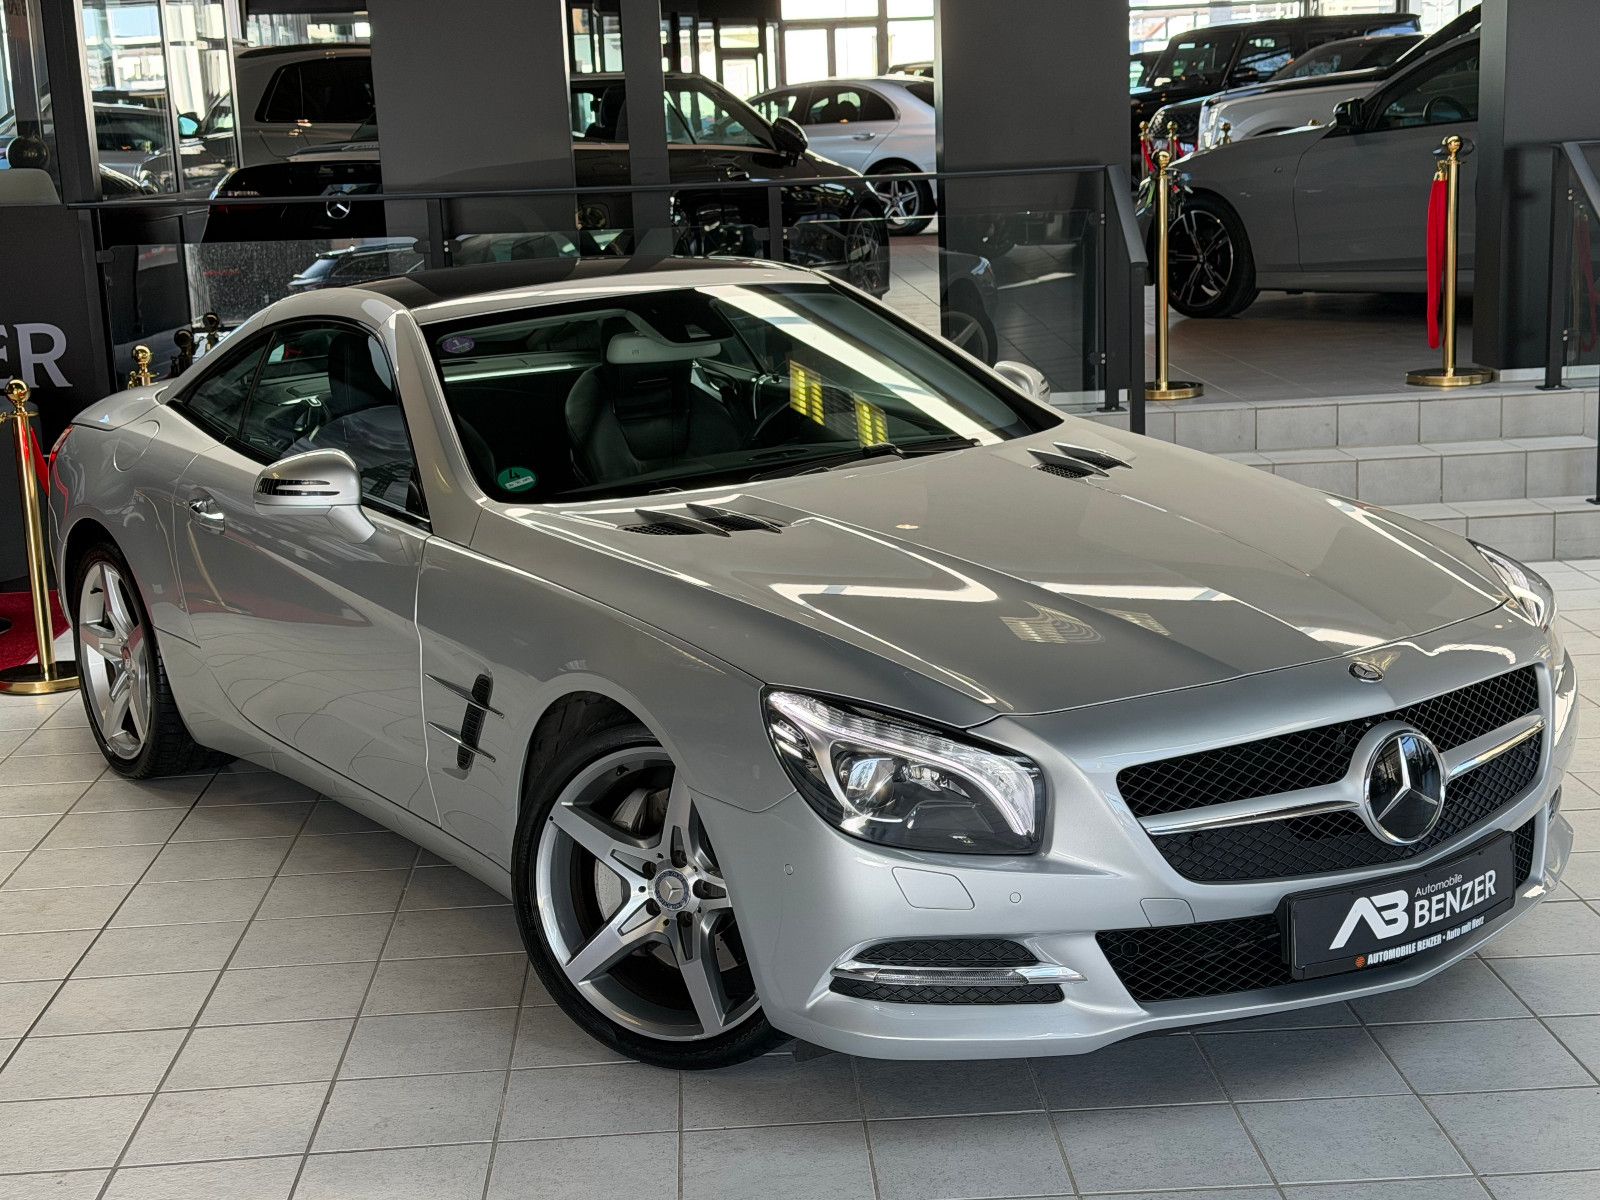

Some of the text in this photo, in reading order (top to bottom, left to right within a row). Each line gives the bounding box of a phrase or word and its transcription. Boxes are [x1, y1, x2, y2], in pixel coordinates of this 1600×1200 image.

[508, 468, 521, 479] 4
[1413, 869, 1497, 929] BENZER
[1414, 873, 1463, 897] Automobile
[1367, 942, 1417, 965] AUTOMOBILE
[1416, 934, 1443, 952] BENZER
[1446, 927, 1461, 941] Auto
